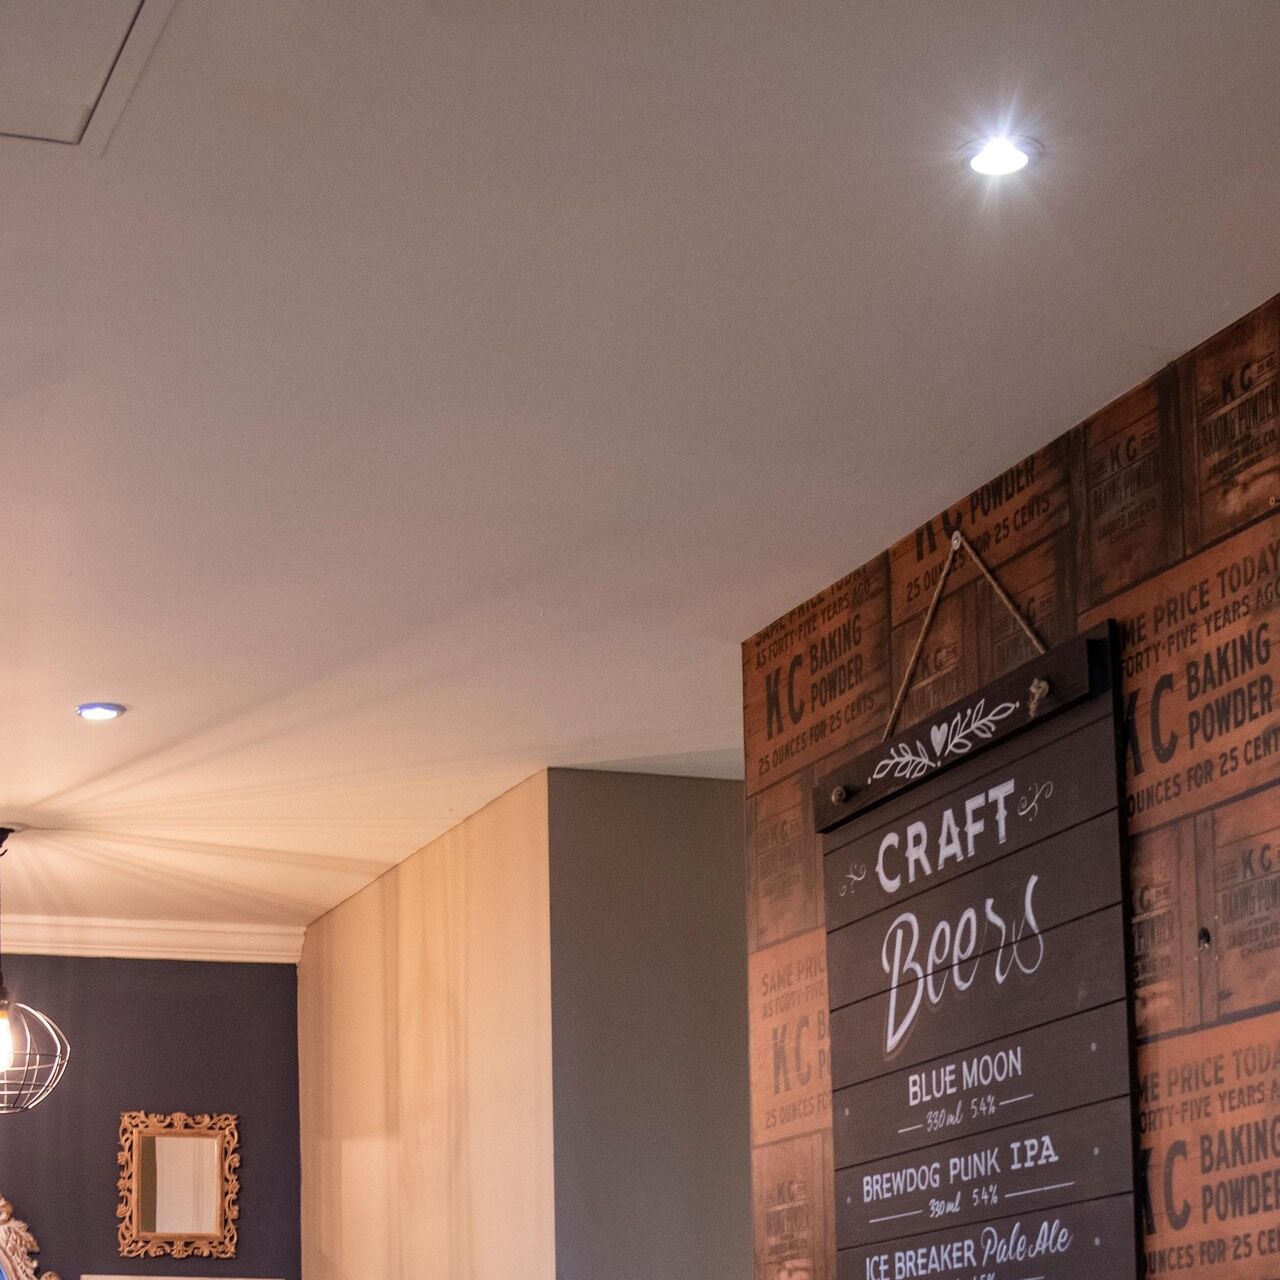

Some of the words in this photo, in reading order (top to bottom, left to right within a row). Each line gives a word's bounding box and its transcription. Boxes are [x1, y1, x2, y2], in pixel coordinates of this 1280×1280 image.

[1153, 579, 1210, 635] PRICE
[1205, 595, 1250, 636] YEARS
[1185, 622, 1271, 702] BAKING
[1188, 674, 1273, 750] POWDER
[1186, 759, 1214, 793] FOR
[1220, 749, 1240, 777] 25
[875, 778, 1015, 893] CRAFT
[881, 874, 1044, 1053] Beers
[908, 1064, 957, 1107] BLUE
[962, 1046, 1023, 1091] MOON
[1167, 1054, 1224, 1098] PRICE
[1217, 1081, 1266, 1115] YEARS
[862, 1162, 941, 1204] BREWDOG
[949, 1147, 1001, 1185] PUNK
[1010, 1135, 1060, 1170] IPA
[893, 1239, 977, 1280] BREAKER
[980, 1226, 1029, 1267] Pale
[1028, 1218, 1074, 1258] Ale
[1199, 1237, 1227, 1266] FOR
[1232, 1232, 1252, 1261] 25
